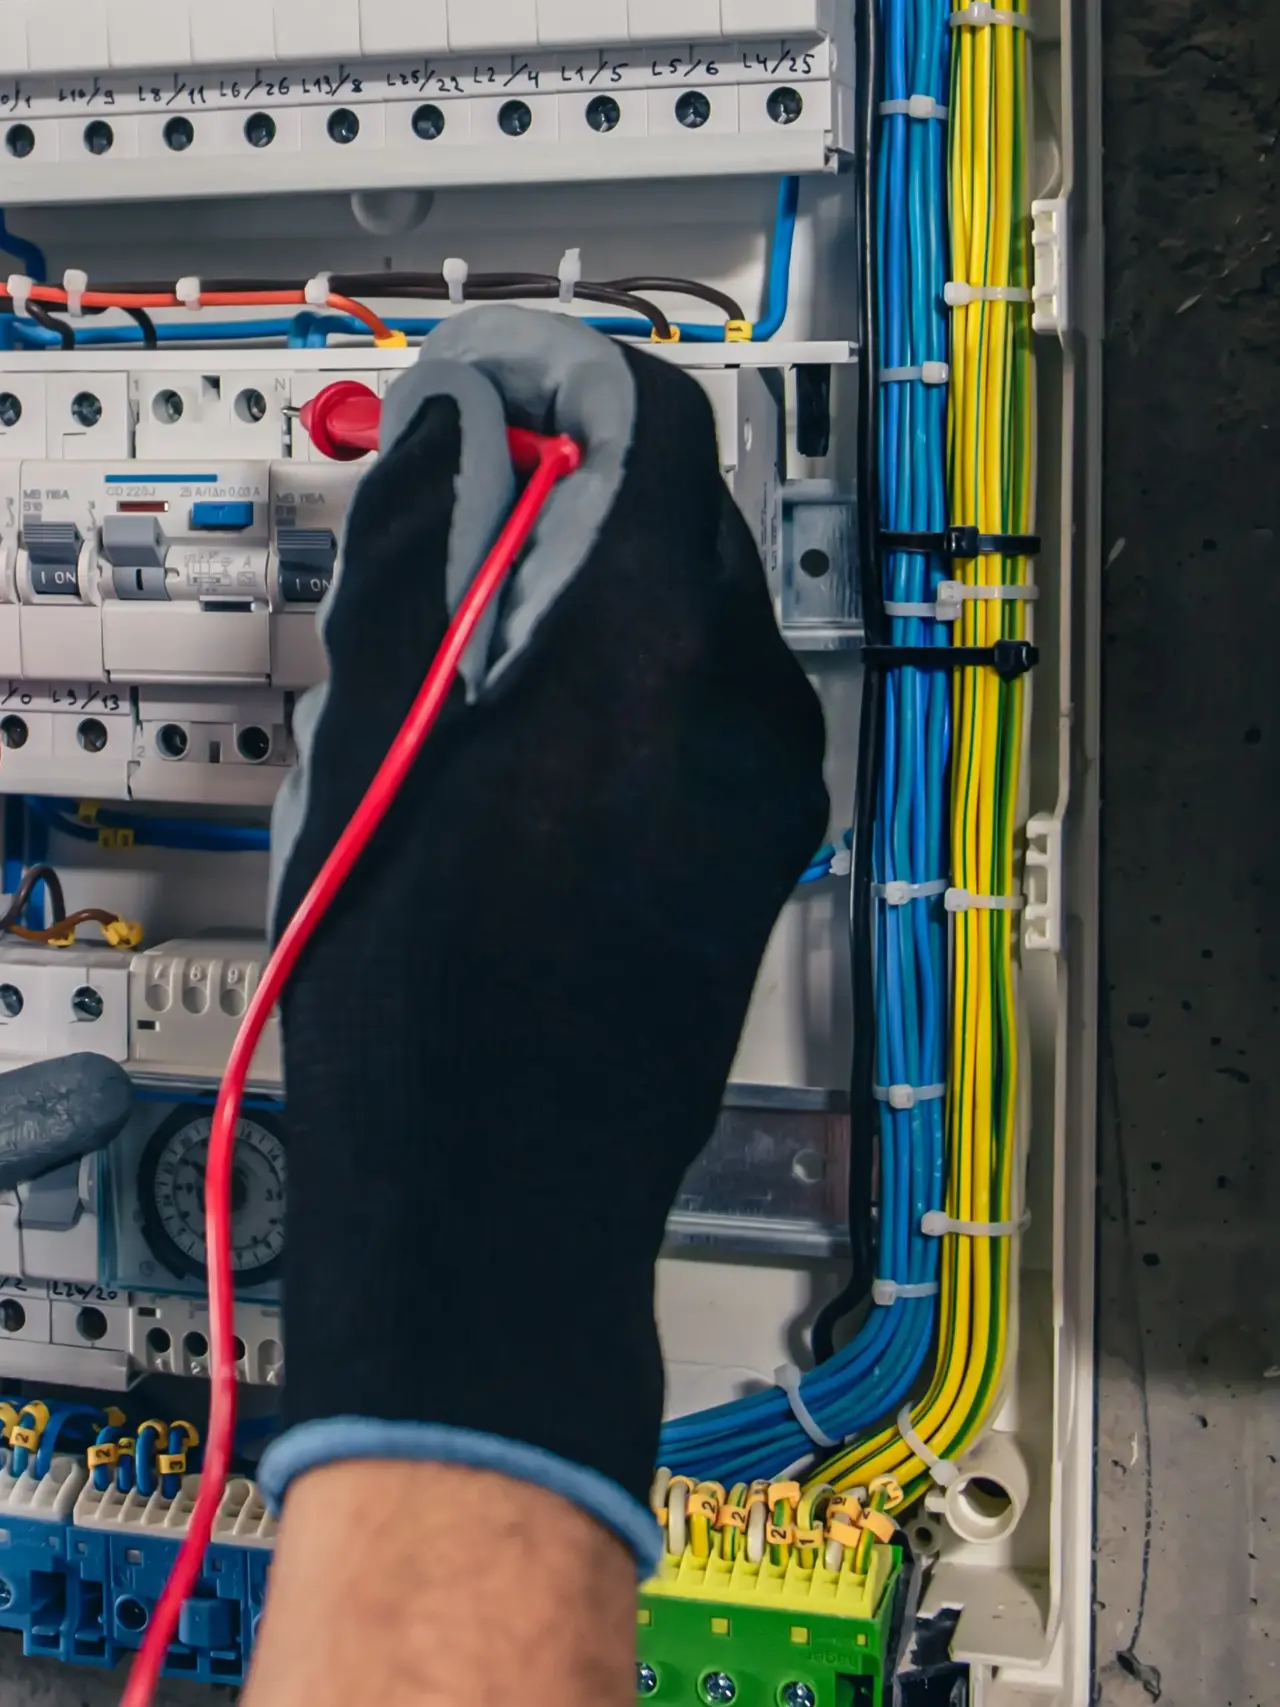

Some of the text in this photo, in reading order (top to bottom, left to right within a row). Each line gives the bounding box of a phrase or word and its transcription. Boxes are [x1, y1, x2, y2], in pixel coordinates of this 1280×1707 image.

[561, 61, 629, 85] L1/5
[652, 59, 720, 78] L5/6
[742, 50, 815, 75] L4/25
[473, 63, 540, 88] L2/4
[220, 77, 290, 100] L6/26
[274, 377, 286, 392] N
[54, 571, 77, 584] ON
[770, 1528, 787, 1540] 2
